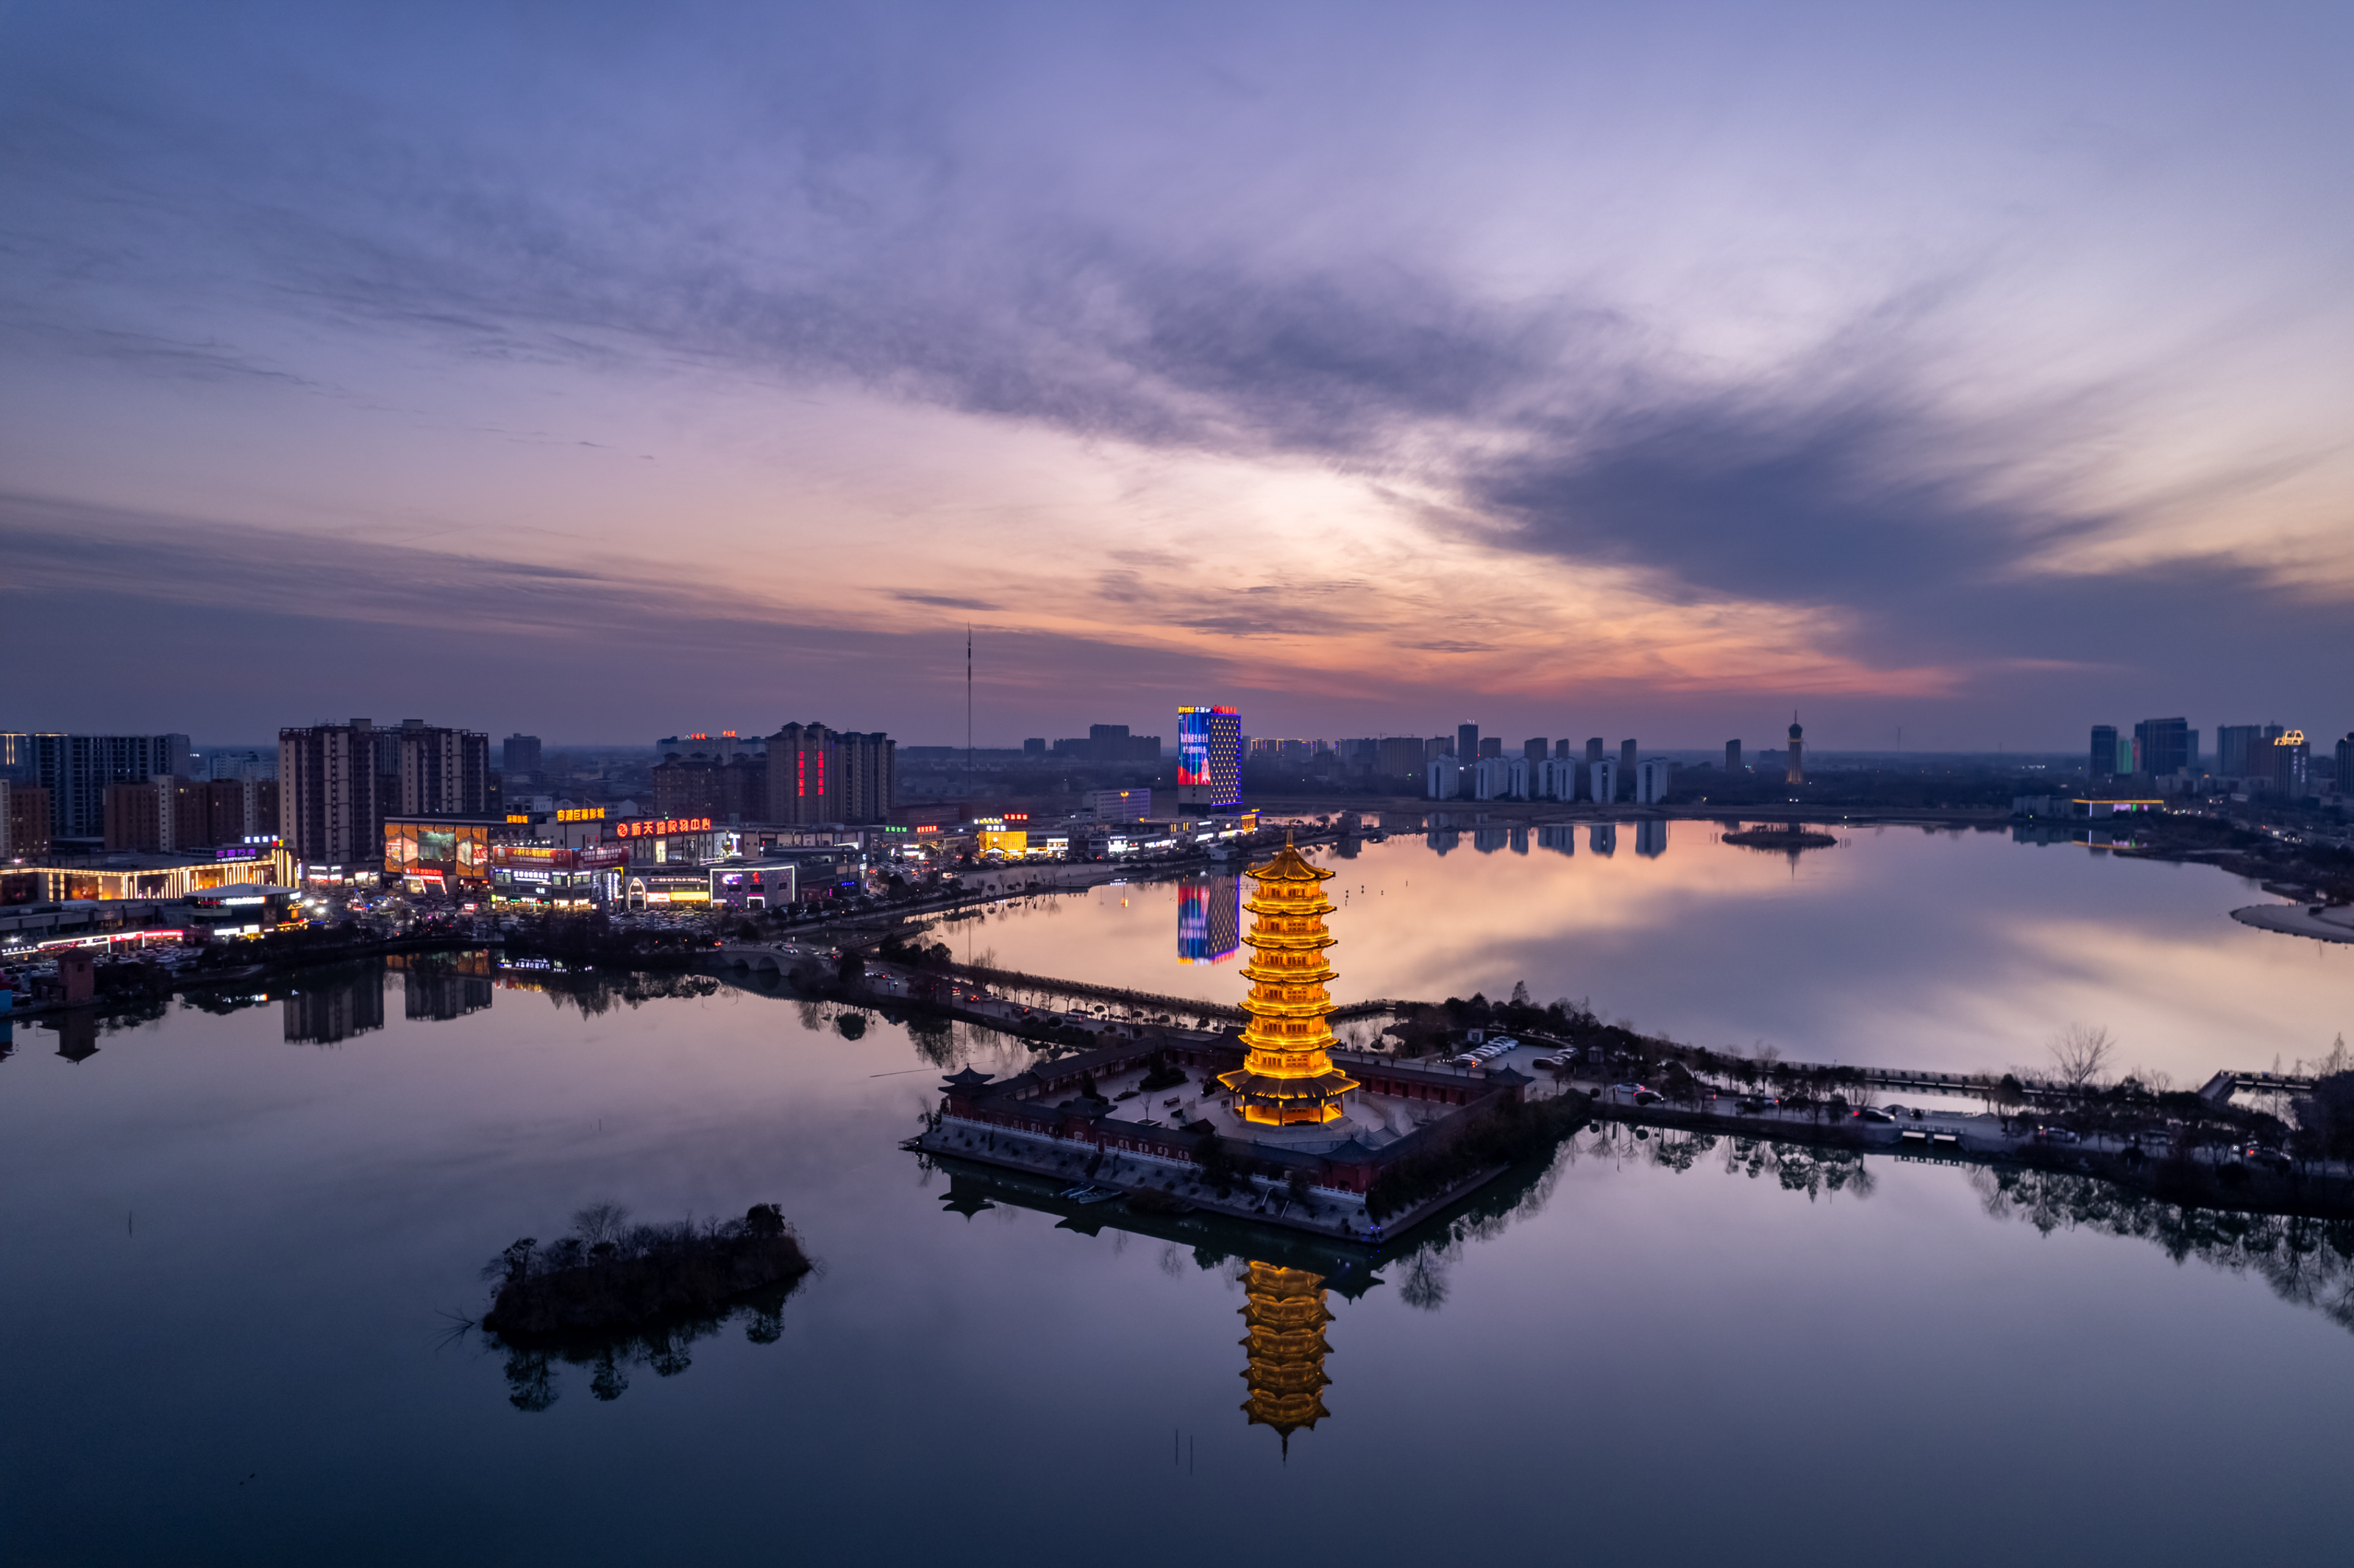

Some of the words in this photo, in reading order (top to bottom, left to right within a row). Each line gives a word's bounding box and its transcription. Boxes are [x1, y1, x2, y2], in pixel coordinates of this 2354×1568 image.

[631, 818, 711, 837] 新天地购物中心
